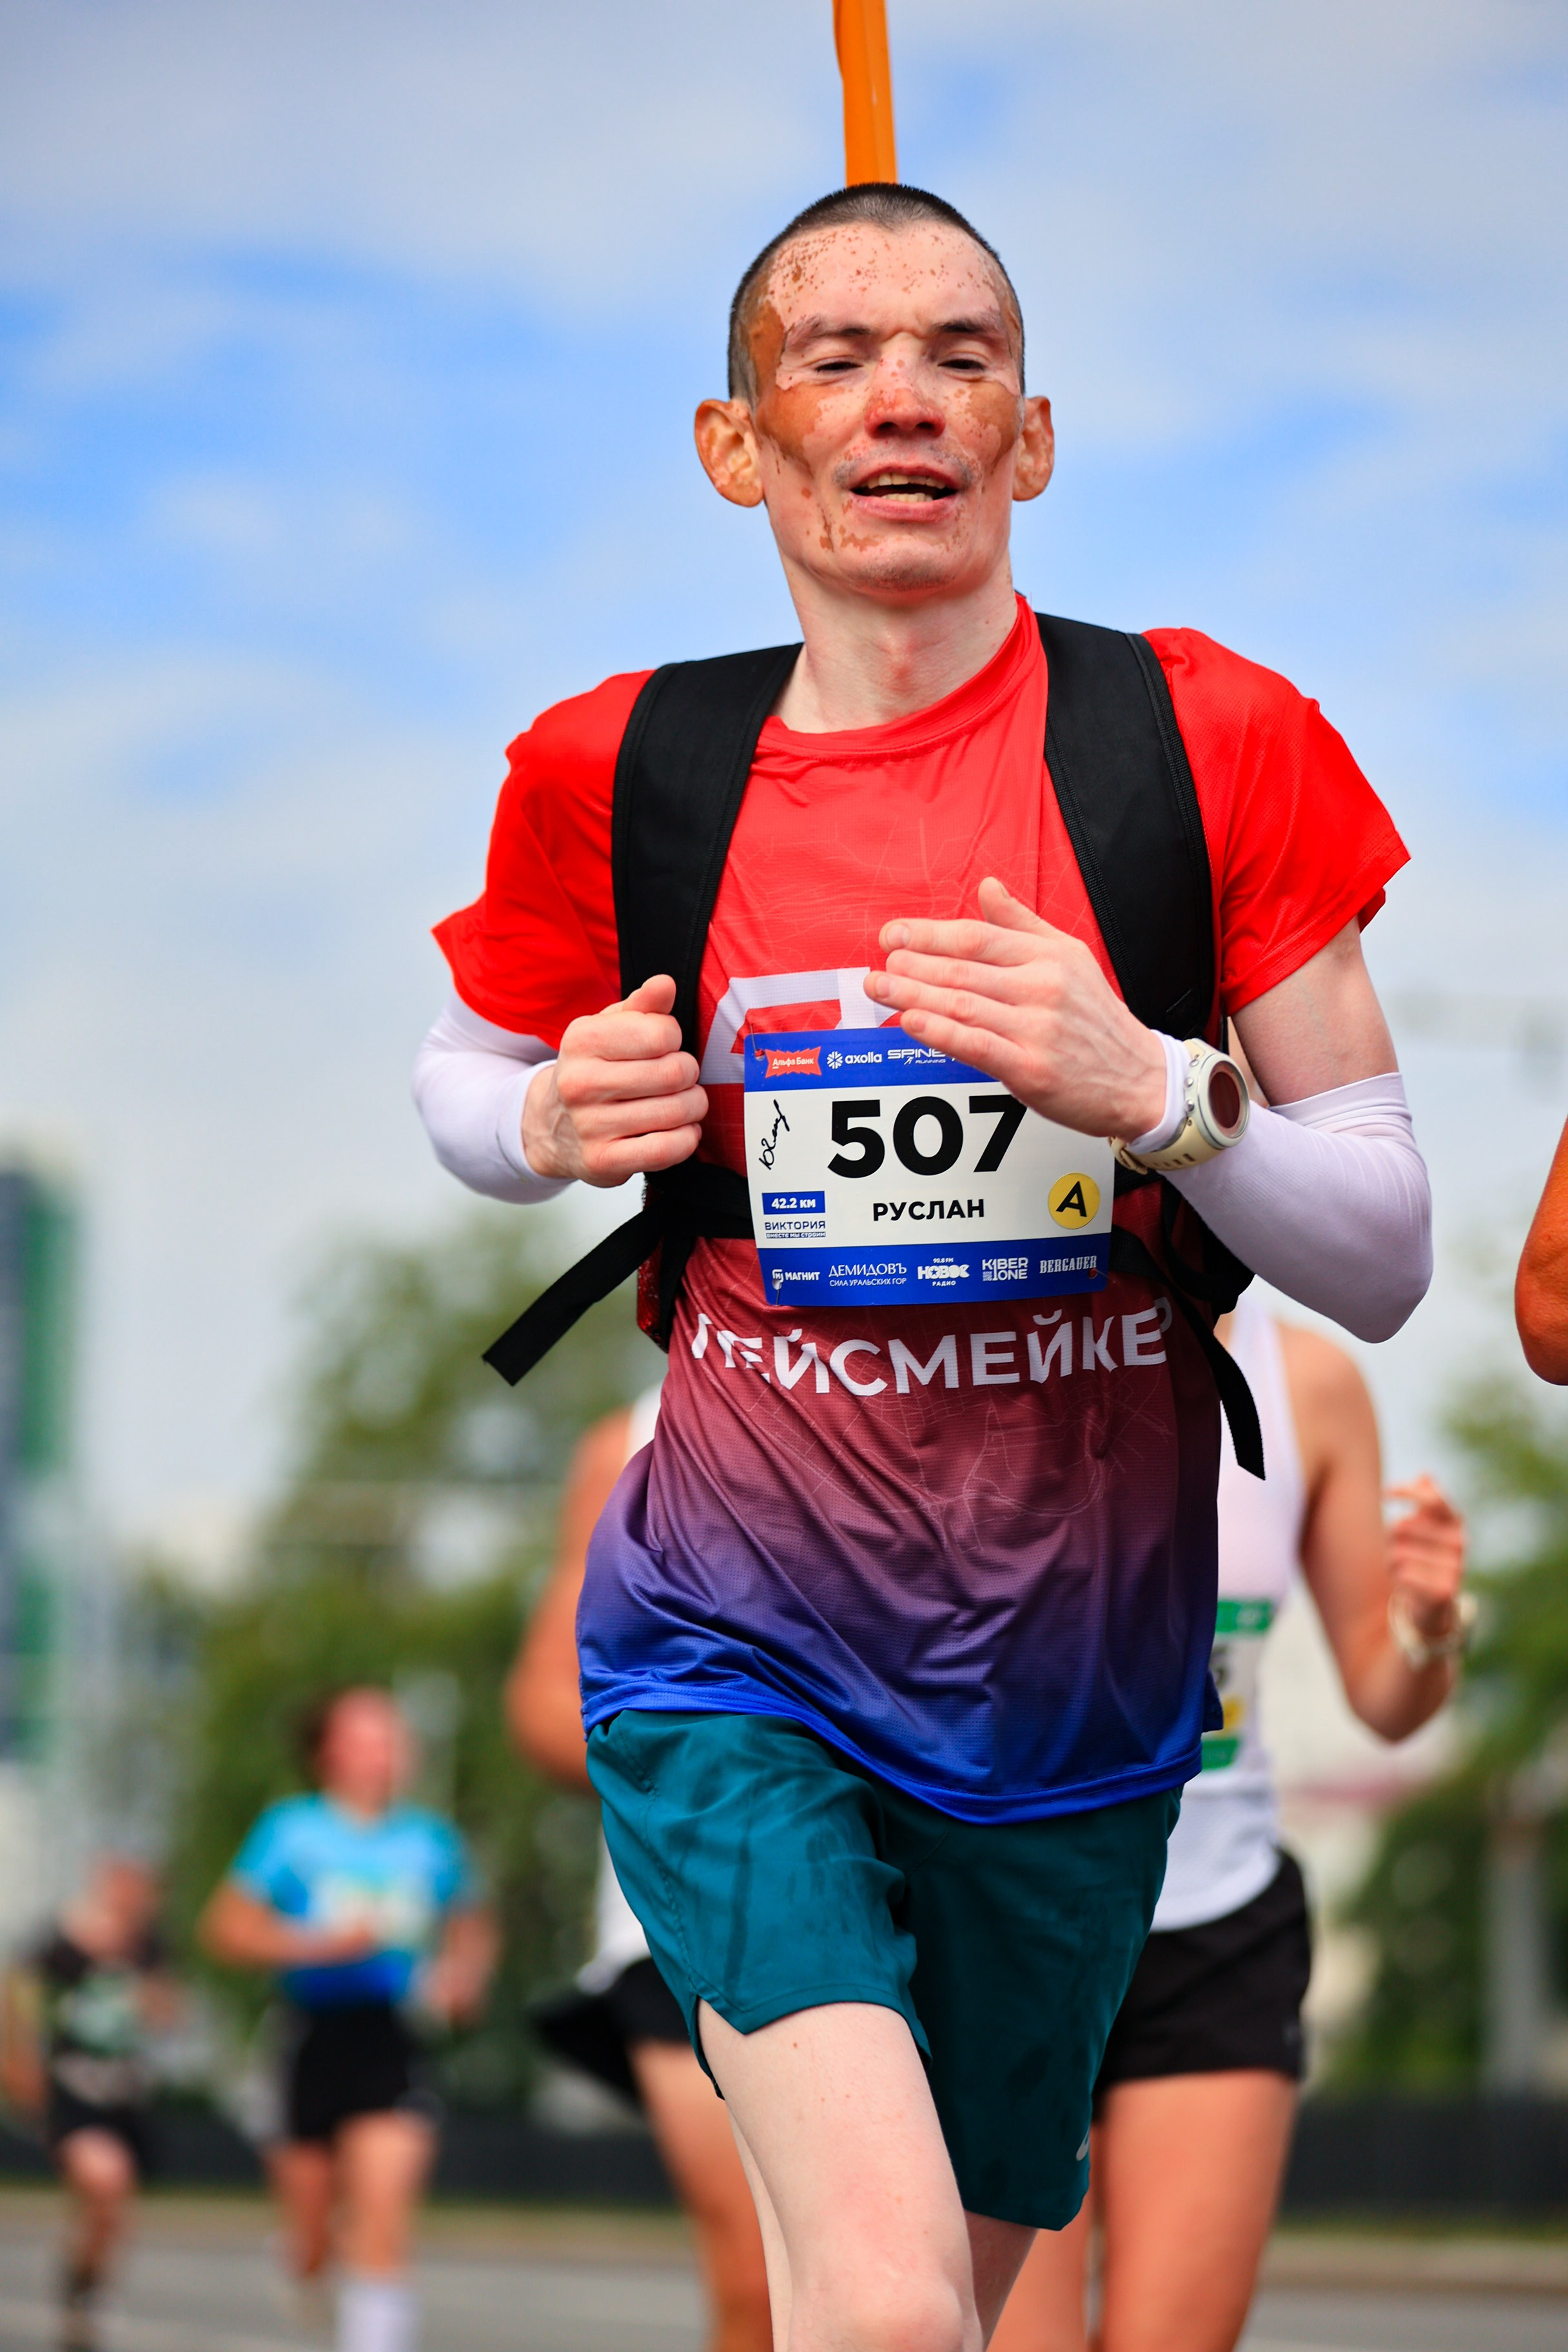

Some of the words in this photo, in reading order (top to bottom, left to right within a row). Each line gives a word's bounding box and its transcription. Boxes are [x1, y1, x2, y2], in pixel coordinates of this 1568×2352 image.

[772, 1057, 796, 1068] Альфа
[845, 1052, 883, 1064] axolla
[827, 1094, 1027, 1179] 507
[771, 1197, 798, 1209] 42.2
[873, 1199, 985, 1221] РУСЛАН
[765, 1220, 826, 1231] ВИКТОРИЯ
[828, 1262, 907, 1278] ДЕМИДОВЪ
[1039, 1255, 1097, 1274] BERGAUER
[785, 1271, 820, 1280] МАГНИТ
[849, 1278, 891, 1286] УРАЛЬСКИХ
